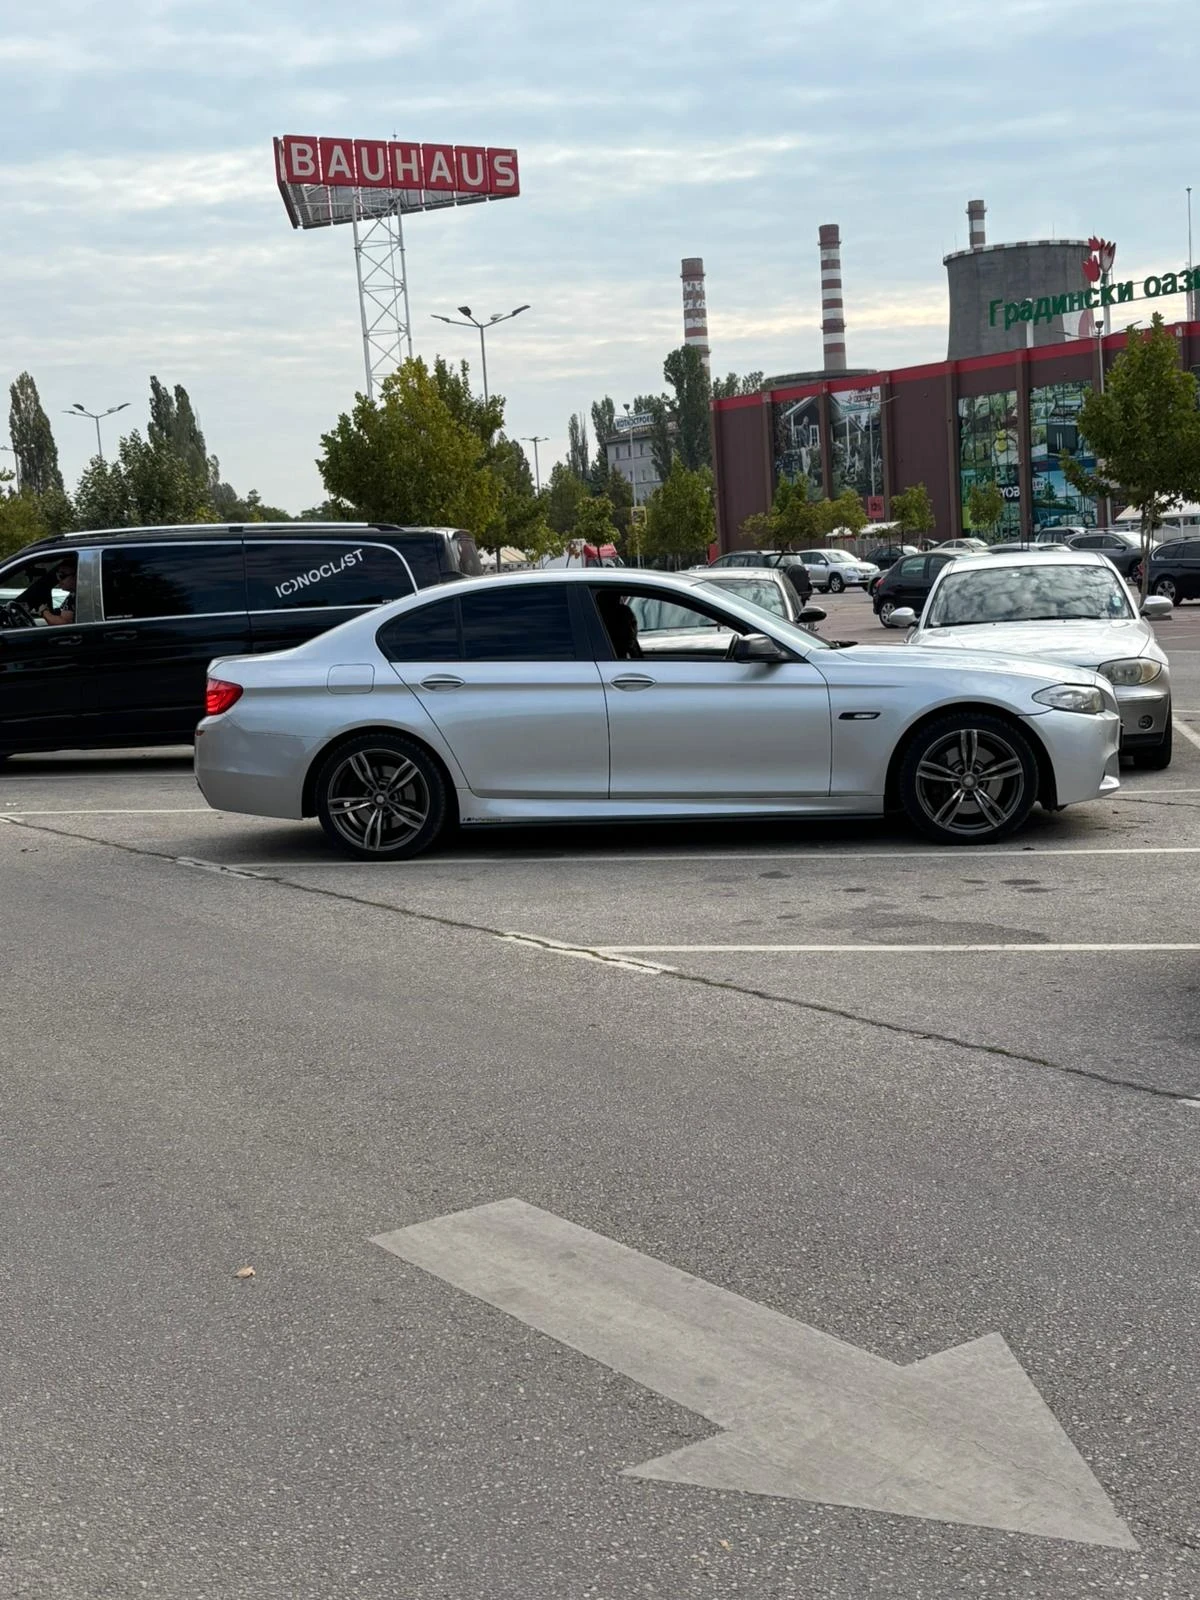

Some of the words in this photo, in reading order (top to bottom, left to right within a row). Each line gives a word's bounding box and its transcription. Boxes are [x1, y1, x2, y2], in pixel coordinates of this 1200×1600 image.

[290, 142, 516, 187] BAUHAUS
[989, 280, 1134, 330] Градински
[1000, 486, 1020, 497] YOB
[274, 548, 363, 598] ICONOCLAST
